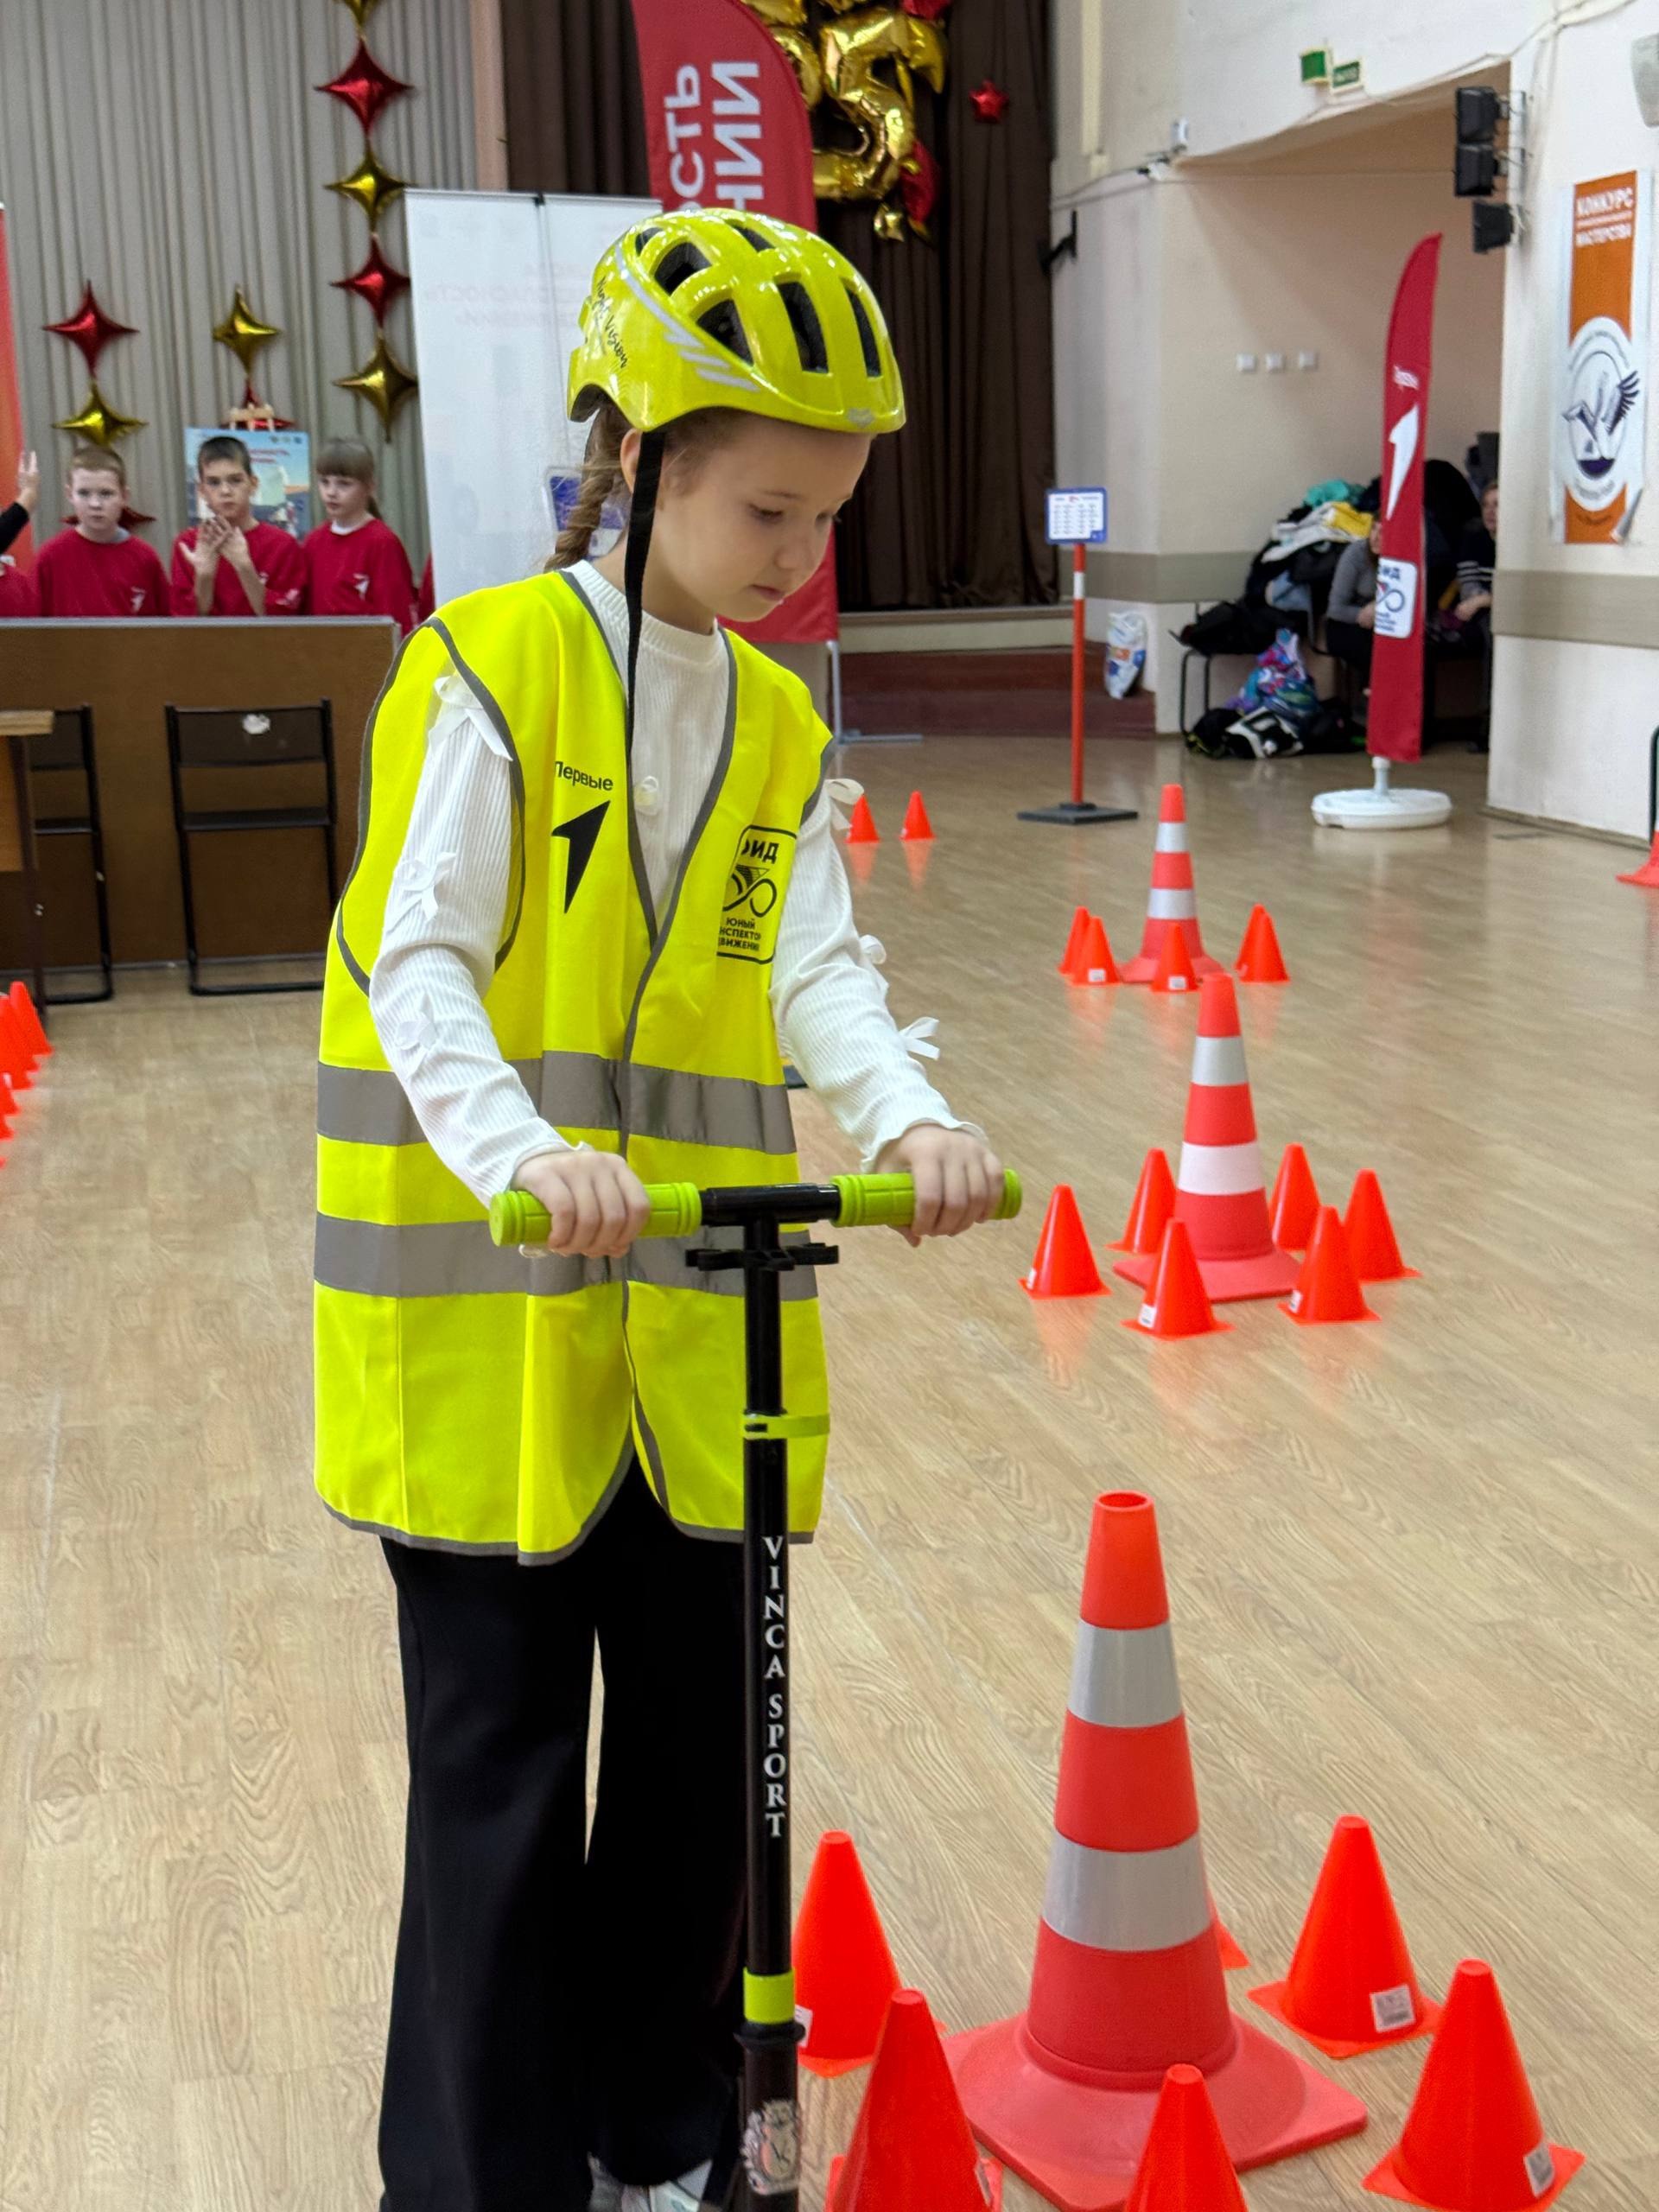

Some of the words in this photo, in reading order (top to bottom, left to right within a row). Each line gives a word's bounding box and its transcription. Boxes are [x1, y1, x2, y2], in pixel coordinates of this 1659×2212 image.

[604, 315, 628, 369] Vision
[555, 760, 613, 791] Первые
[726, 917, 756, 931] ЮНЫЙ
[761, 1535, 786, 1679] VINCA
[762, 1693, 788, 1838] SPORT
